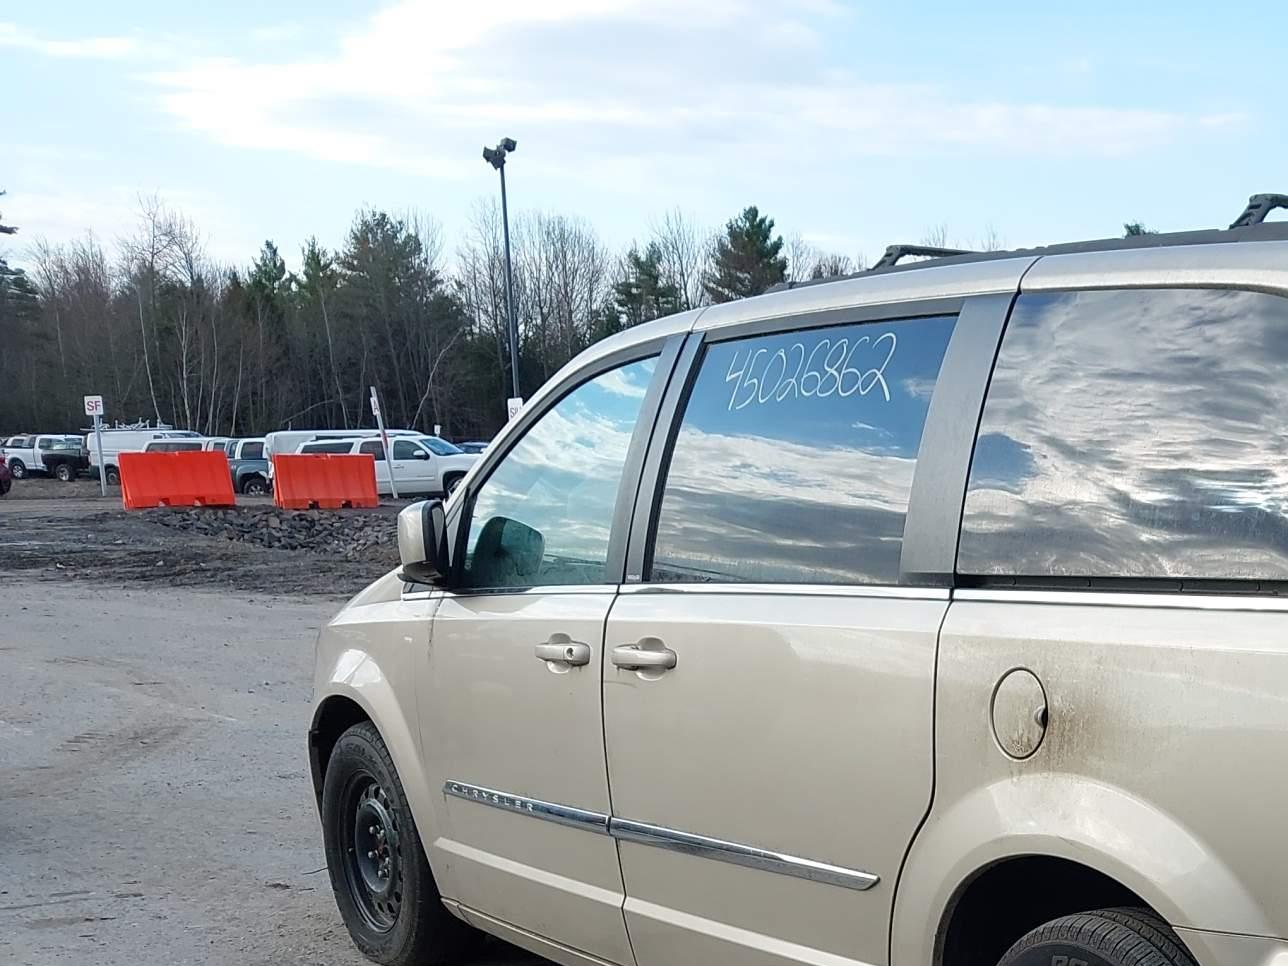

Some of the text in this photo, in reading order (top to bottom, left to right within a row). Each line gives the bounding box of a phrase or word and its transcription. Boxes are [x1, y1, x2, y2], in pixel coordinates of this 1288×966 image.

[725, 332, 896, 411] 45026862
[87, 400, 101, 411] SF
[451, 784, 534, 812] CHRYSLER
